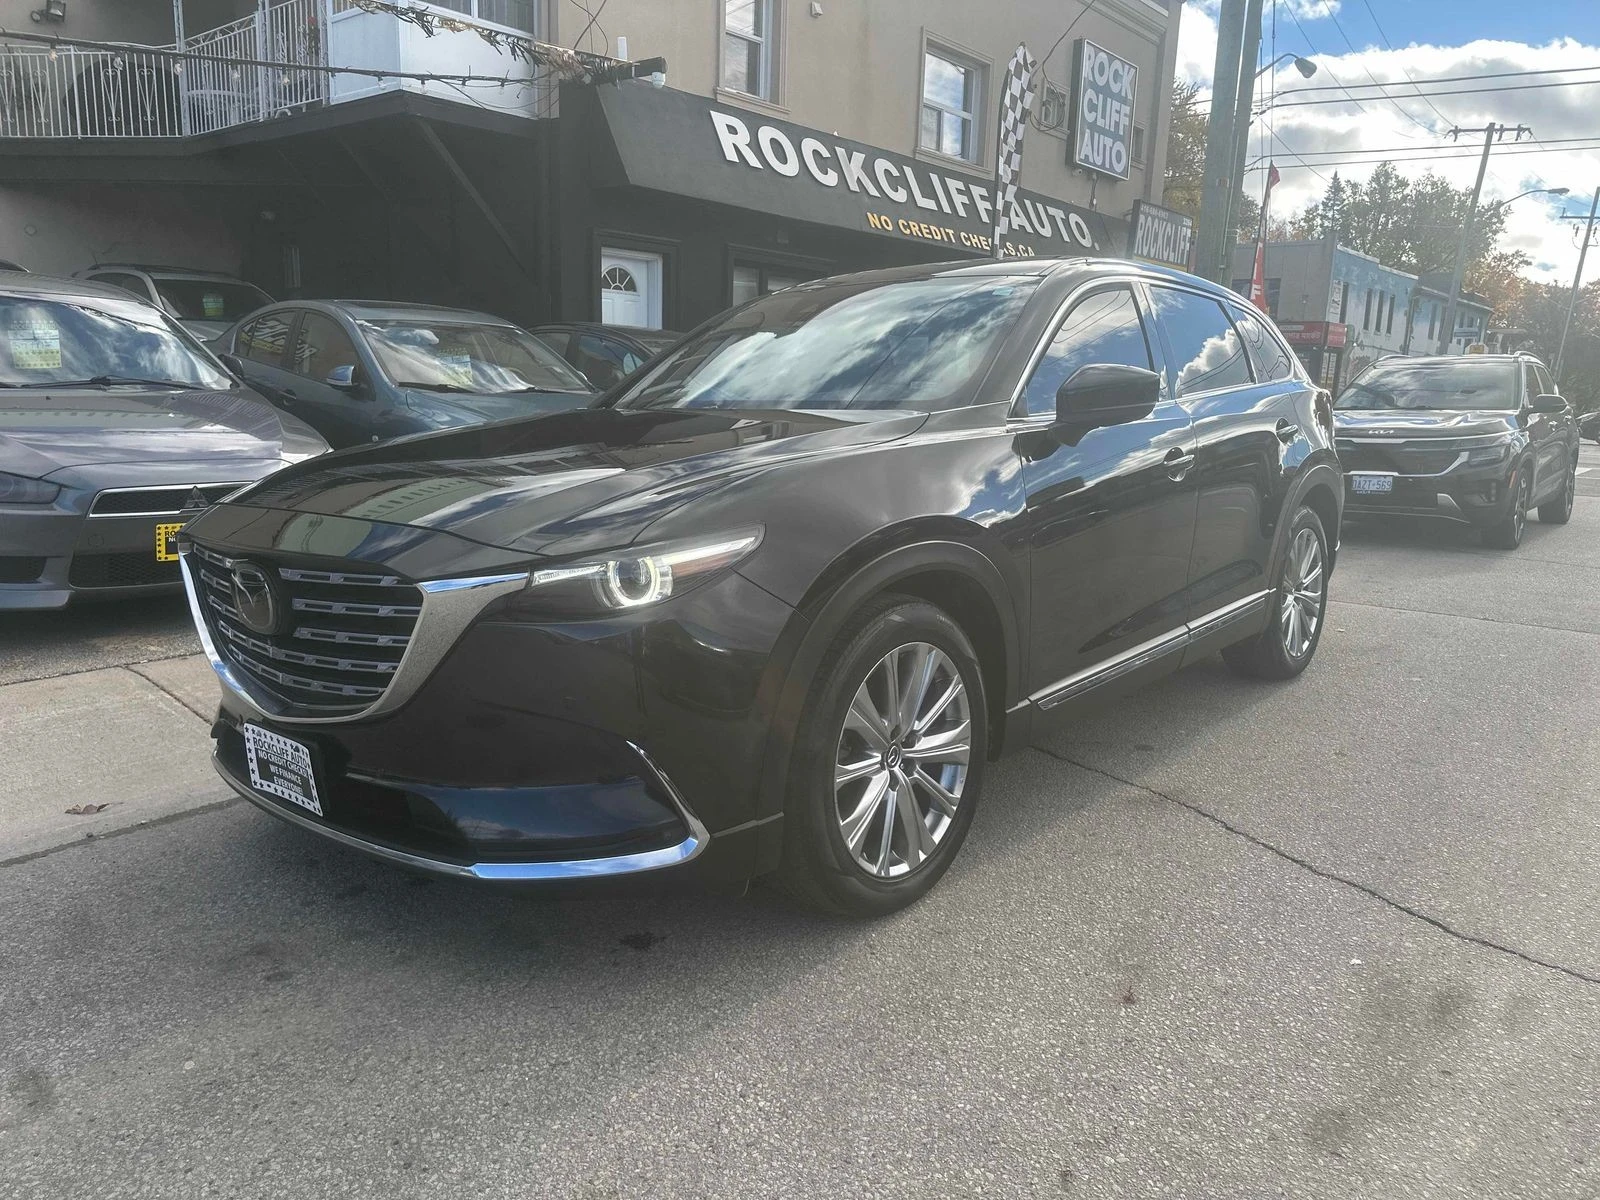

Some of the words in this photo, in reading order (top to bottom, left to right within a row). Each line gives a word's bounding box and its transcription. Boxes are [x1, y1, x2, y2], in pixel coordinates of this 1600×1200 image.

[1084, 44, 1136, 100] ROCK
[1083, 88, 1130, 135] CLIFF
[709, 110, 992, 223] ROCKCLIFF
[1080, 128, 1126, 172] AUTO
[867, 212, 893, 231] NO
[898, 219, 955, 243] CREDIT
[1134, 214, 1192, 264] ROCKCLIFF
[252, 736, 289, 759] ROCKCLIFF
[290, 751, 308, 769] AUTO
[258, 749, 268, 760] NO
